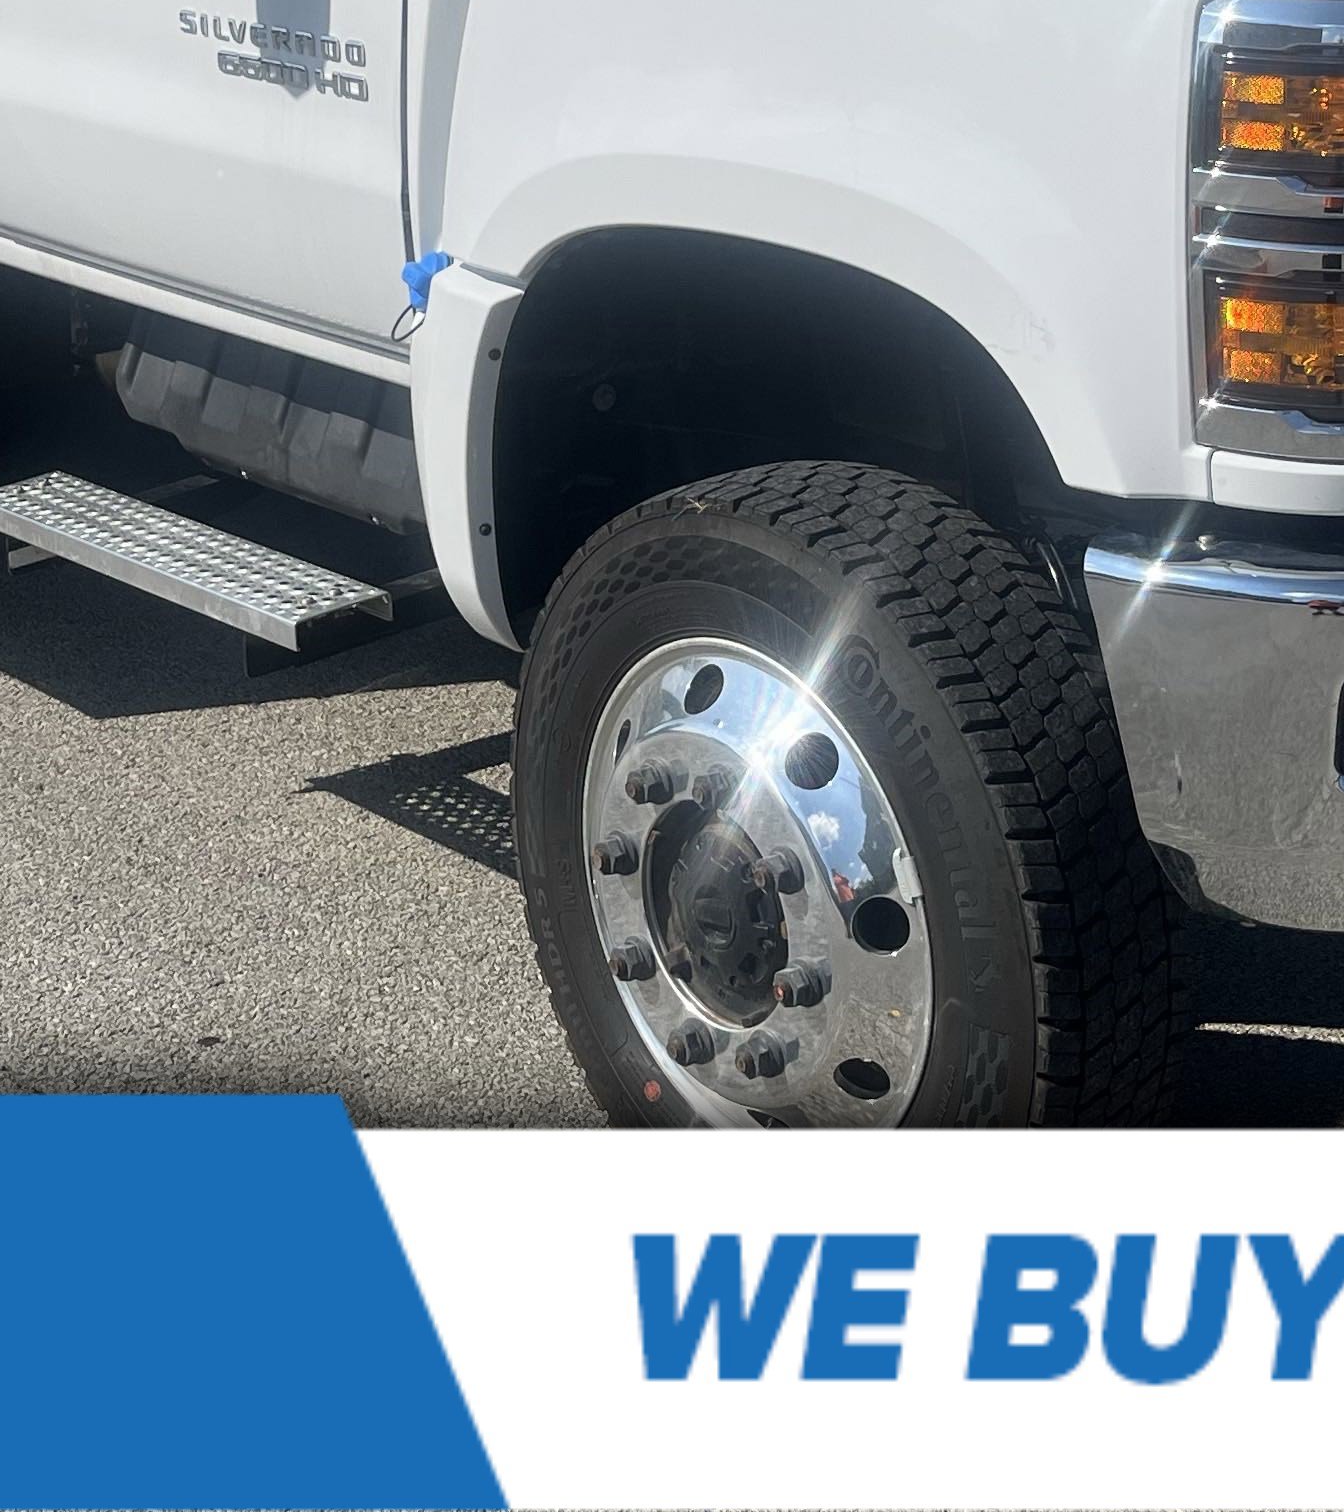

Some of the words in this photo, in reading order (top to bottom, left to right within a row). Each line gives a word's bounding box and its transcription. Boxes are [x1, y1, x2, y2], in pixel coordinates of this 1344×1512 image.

[179, 9, 367, 68] SILVERADO
[314, 68, 369, 102] HD
[839, 633, 997, 939] Continental
